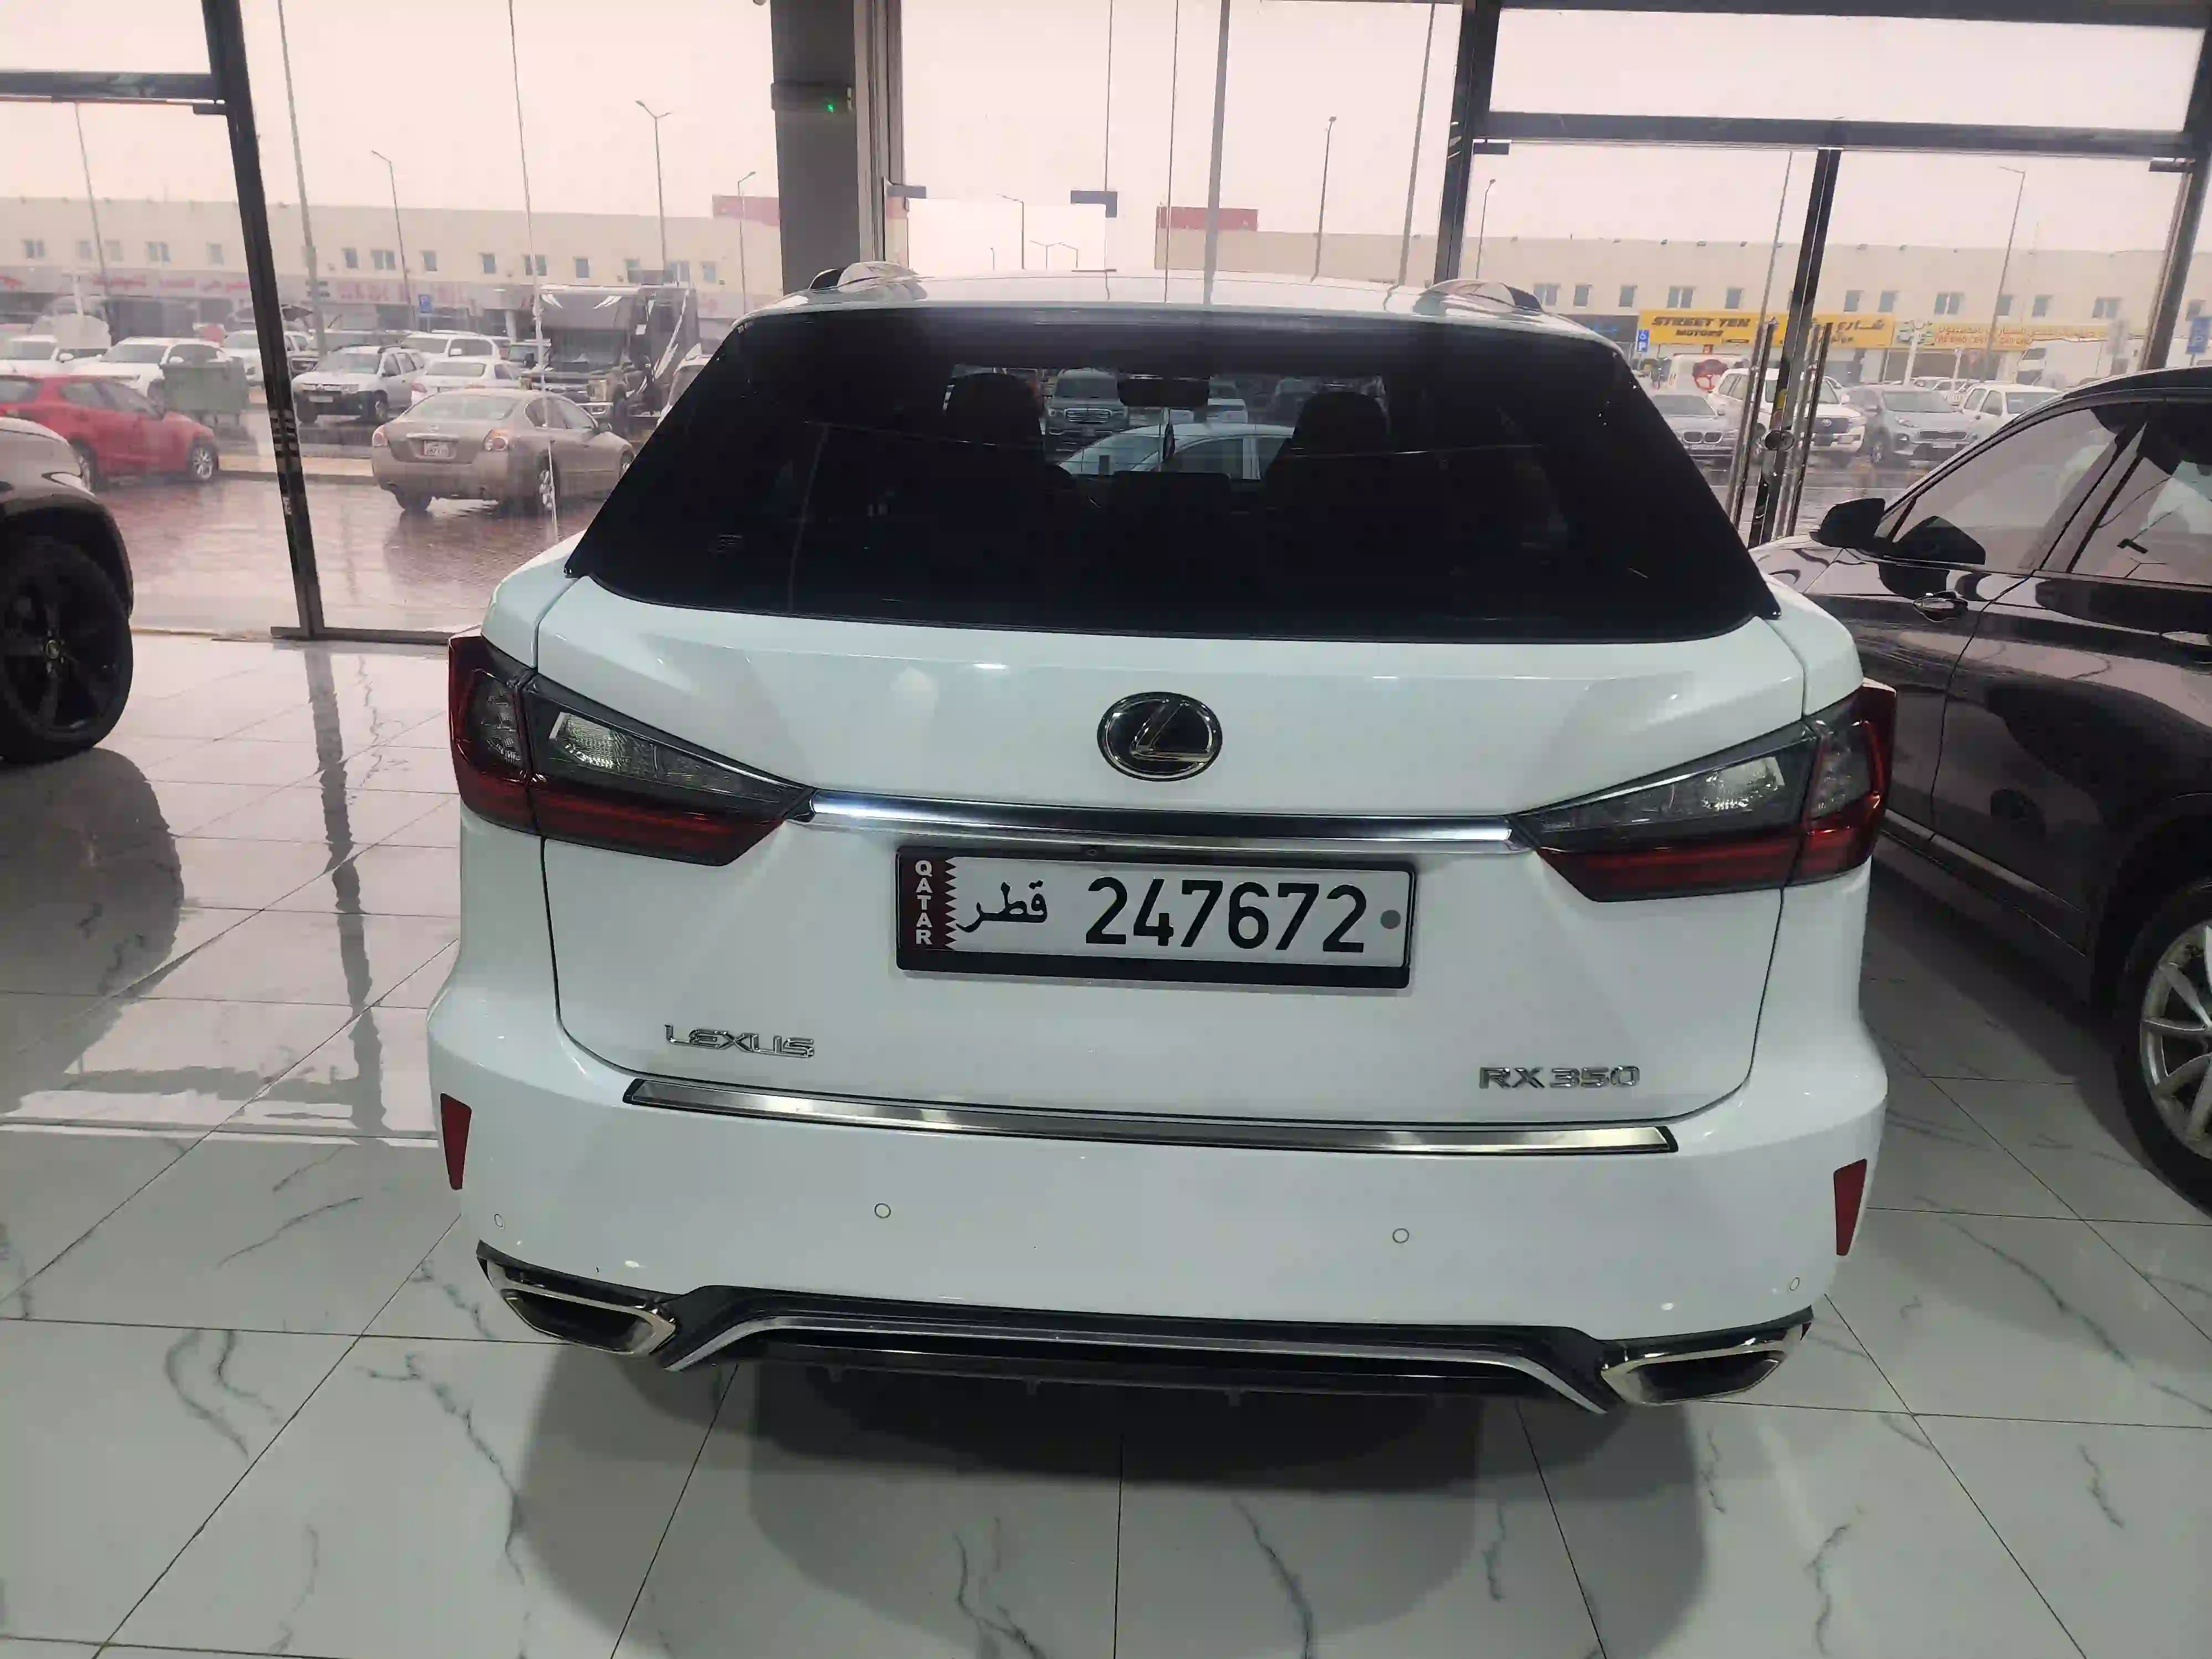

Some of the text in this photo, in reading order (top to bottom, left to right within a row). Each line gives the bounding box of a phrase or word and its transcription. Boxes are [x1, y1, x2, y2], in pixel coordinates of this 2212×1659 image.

[1652, 316, 1714, 326] STREET
[915, 860, 933, 945] QATAR
[956, 878, 1048, 933] قطر
[1086, 876, 1367, 953] 247672
[664, 1024, 814, 1058] LEXUS
